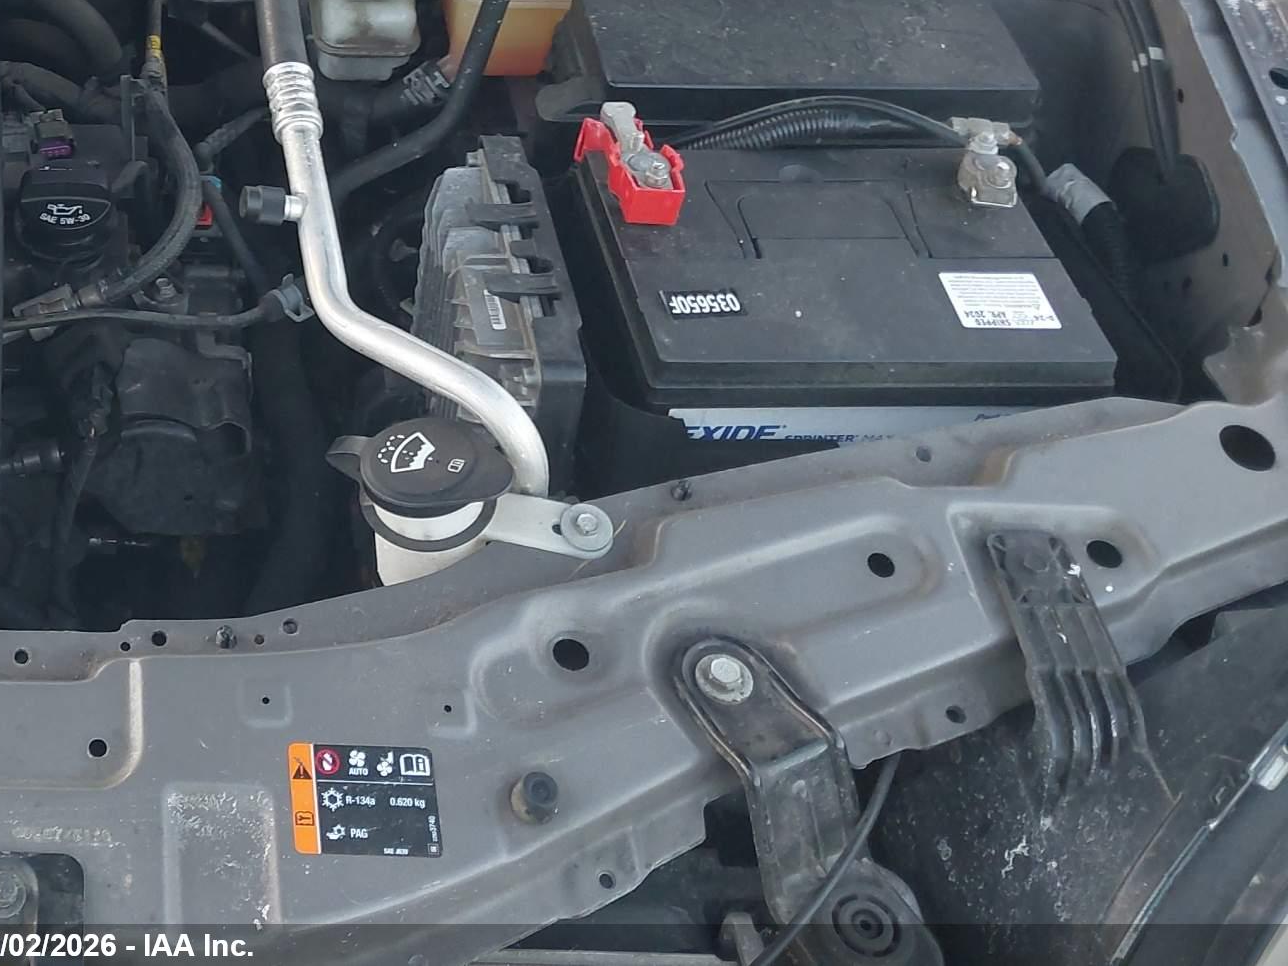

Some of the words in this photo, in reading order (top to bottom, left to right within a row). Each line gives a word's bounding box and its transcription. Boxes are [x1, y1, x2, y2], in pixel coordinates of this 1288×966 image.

[39, 213, 57, 224] SAE
[59, 213, 91, 225] 5W-30
[669, 293, 741, 315] 035650F
[348, 768, 369, 776] AUTO
[345, 796, 376, 807] R-134a
[389, 797, 412, 807] 0.620
[414, 798, 426, 810] kg
[350, 828, 369, 839] PAG
